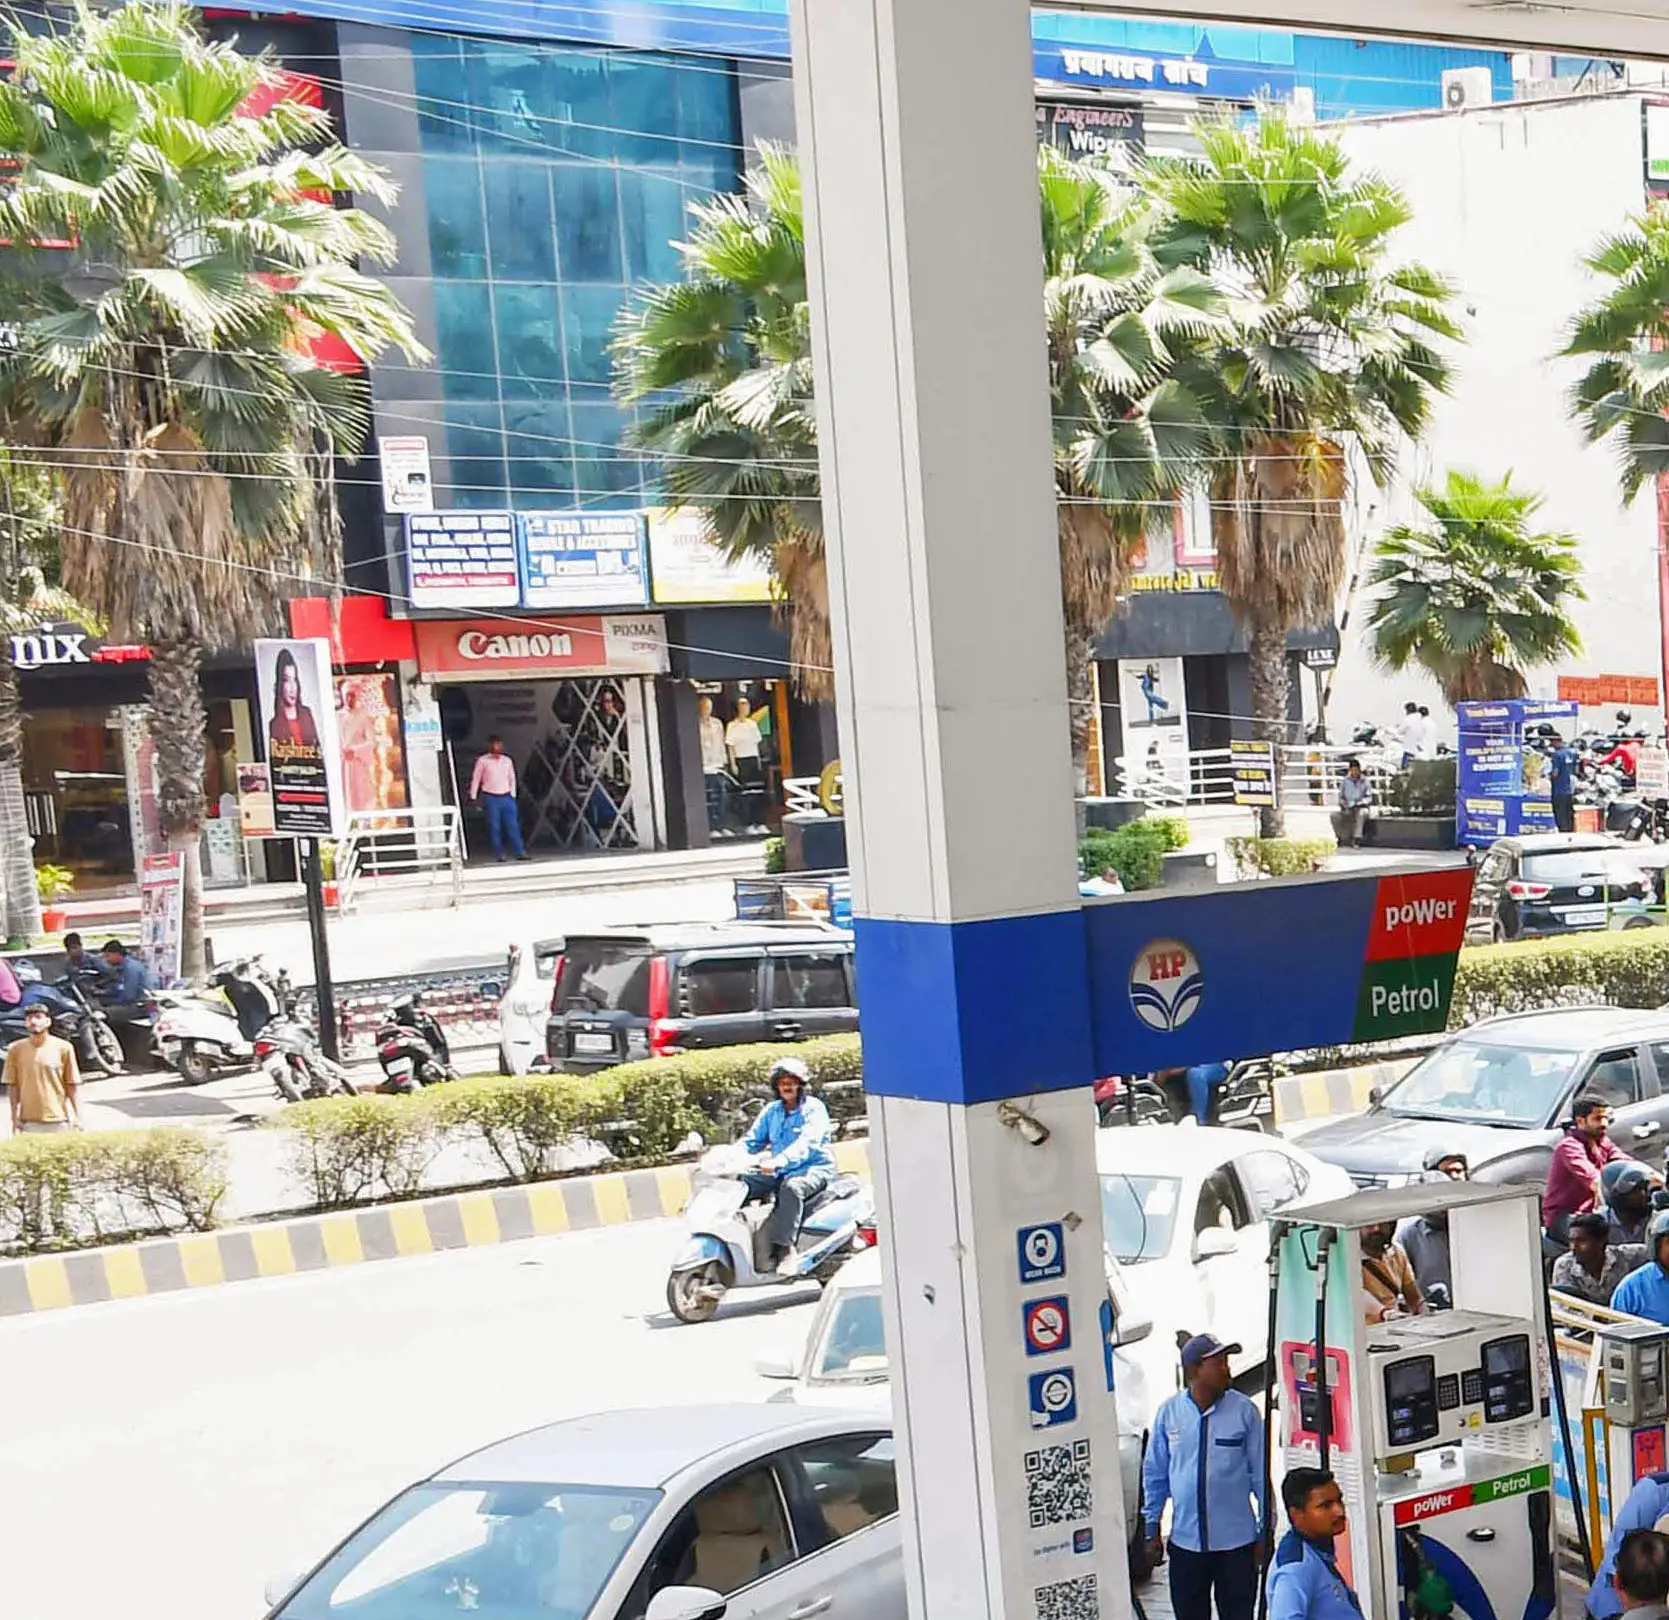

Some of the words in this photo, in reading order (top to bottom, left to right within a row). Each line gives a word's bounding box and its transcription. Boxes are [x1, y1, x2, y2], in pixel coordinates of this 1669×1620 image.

[457, 630, 573, 660] Canon
[612, 624, 657, 636] PIXMA
[1147, 949, 1187, 983] HP
[1370, 979, 1441, 1017] Petrol
[1493, 1477, 1532, 1497] Petrol
